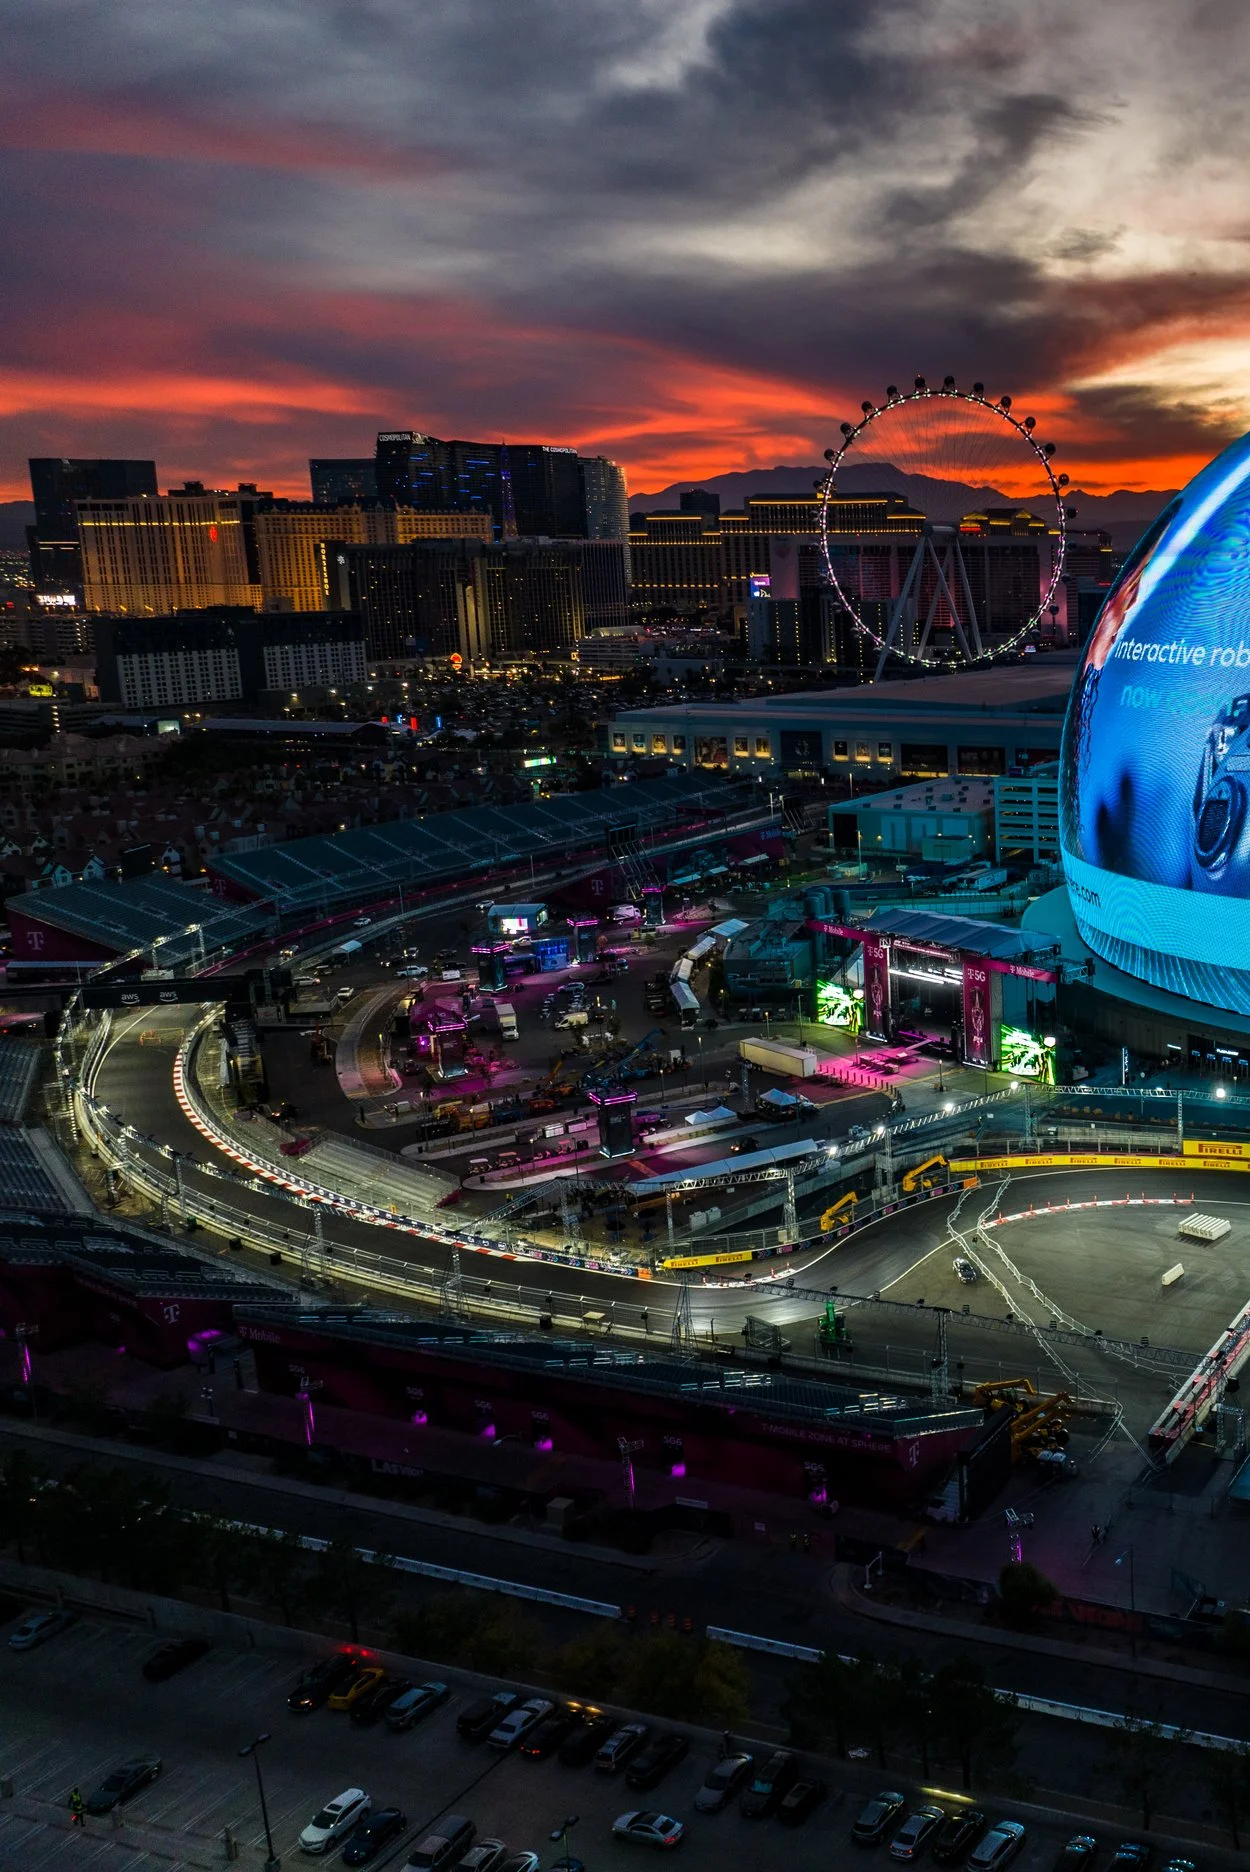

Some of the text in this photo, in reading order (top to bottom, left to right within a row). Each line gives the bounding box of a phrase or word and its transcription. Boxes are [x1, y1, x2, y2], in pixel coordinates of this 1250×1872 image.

[379, 433, 411, 442] COSMOPOLITAN
[1114, 638, 1206, 666] interactive
[829, 925, 844, 937] Mobile
[873, 946, 884, 959] 5G
[974, 969, 986, 982] 5G
[1016, 965, 1035, 978] Mobile
[121, 993, 139, 1002] aws
[160, 991, 177, 999] aws
[1198, 1143, 1243, 1156] PIRELLI
[980, 1159, 1008, 1169] PIRELLI
[1025, 1157, 1053, 1165] PIRELLI
[1069, 1156, 1098, 1164] PIRELLI
[1114, 1157, 1142, 1165] PIRELLI
[1158, 1159, 1186, 1167] PIRELLI
[1203, 1160, 1231, 1169] PIRELLI
[670, 1253, 743, 1269] PIRELLI PIRELLI
[249, 1326, 281, 1345] Mobile
[807, 1431, 835, 1444] ZONE
[836, 1436, 850, 1447] AT
[851, 1439, 891, 1454] SPHERE
